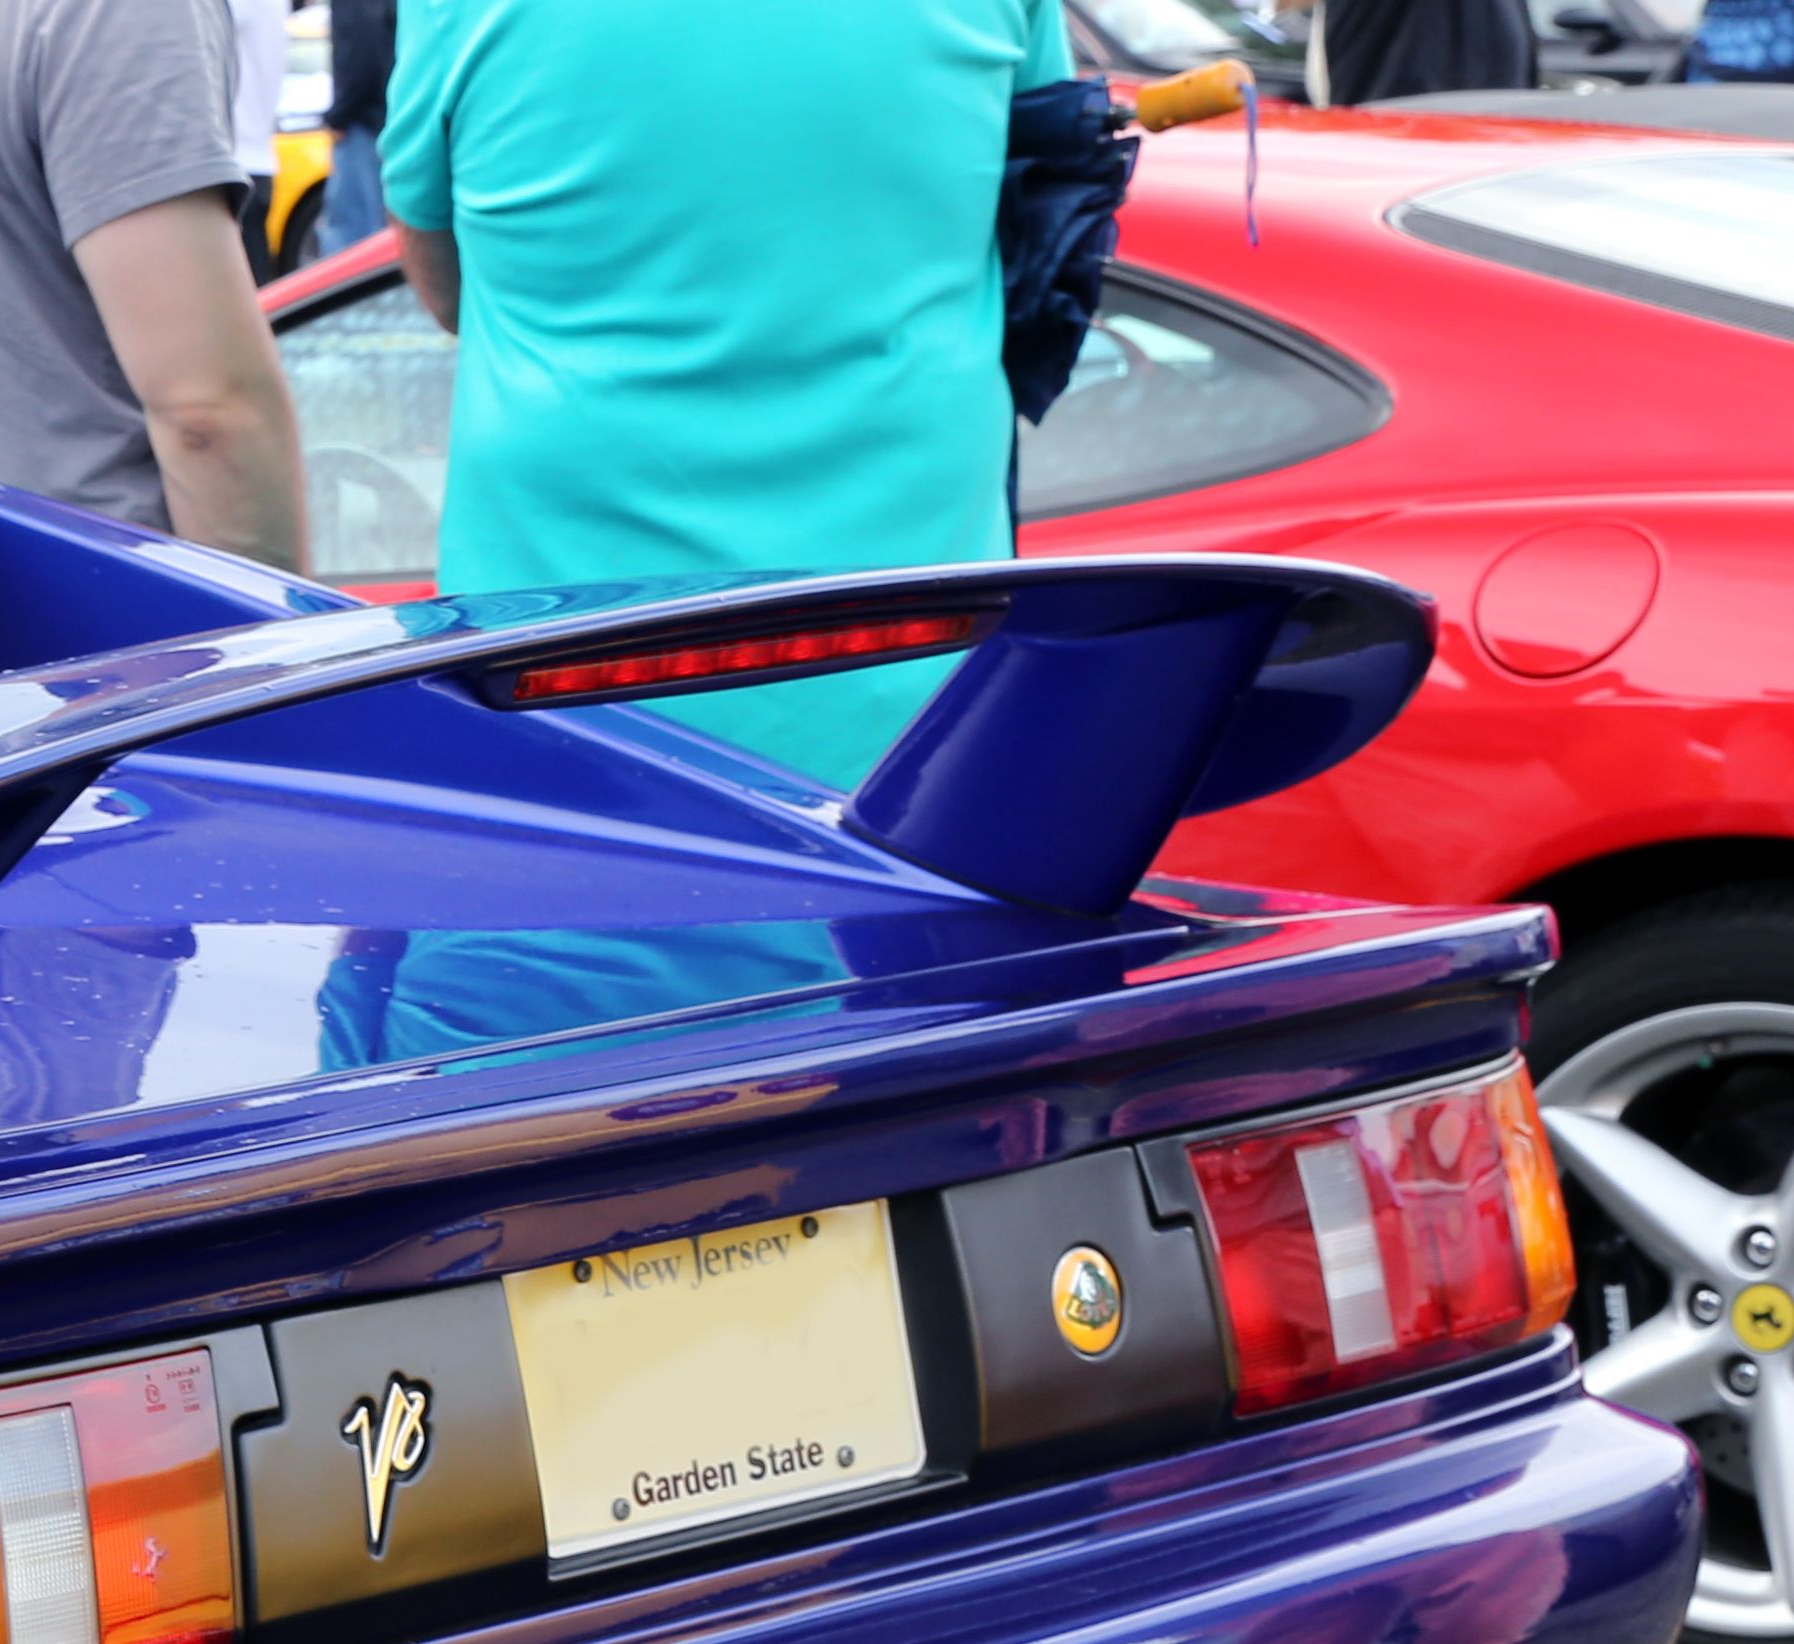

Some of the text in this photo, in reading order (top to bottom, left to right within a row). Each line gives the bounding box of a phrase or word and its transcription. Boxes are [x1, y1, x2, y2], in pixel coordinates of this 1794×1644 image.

[601, 1251, 682, 1299] New
[343, 1381, 426, 1544] V8
[632, 1437, 824, 1507] Garden State
